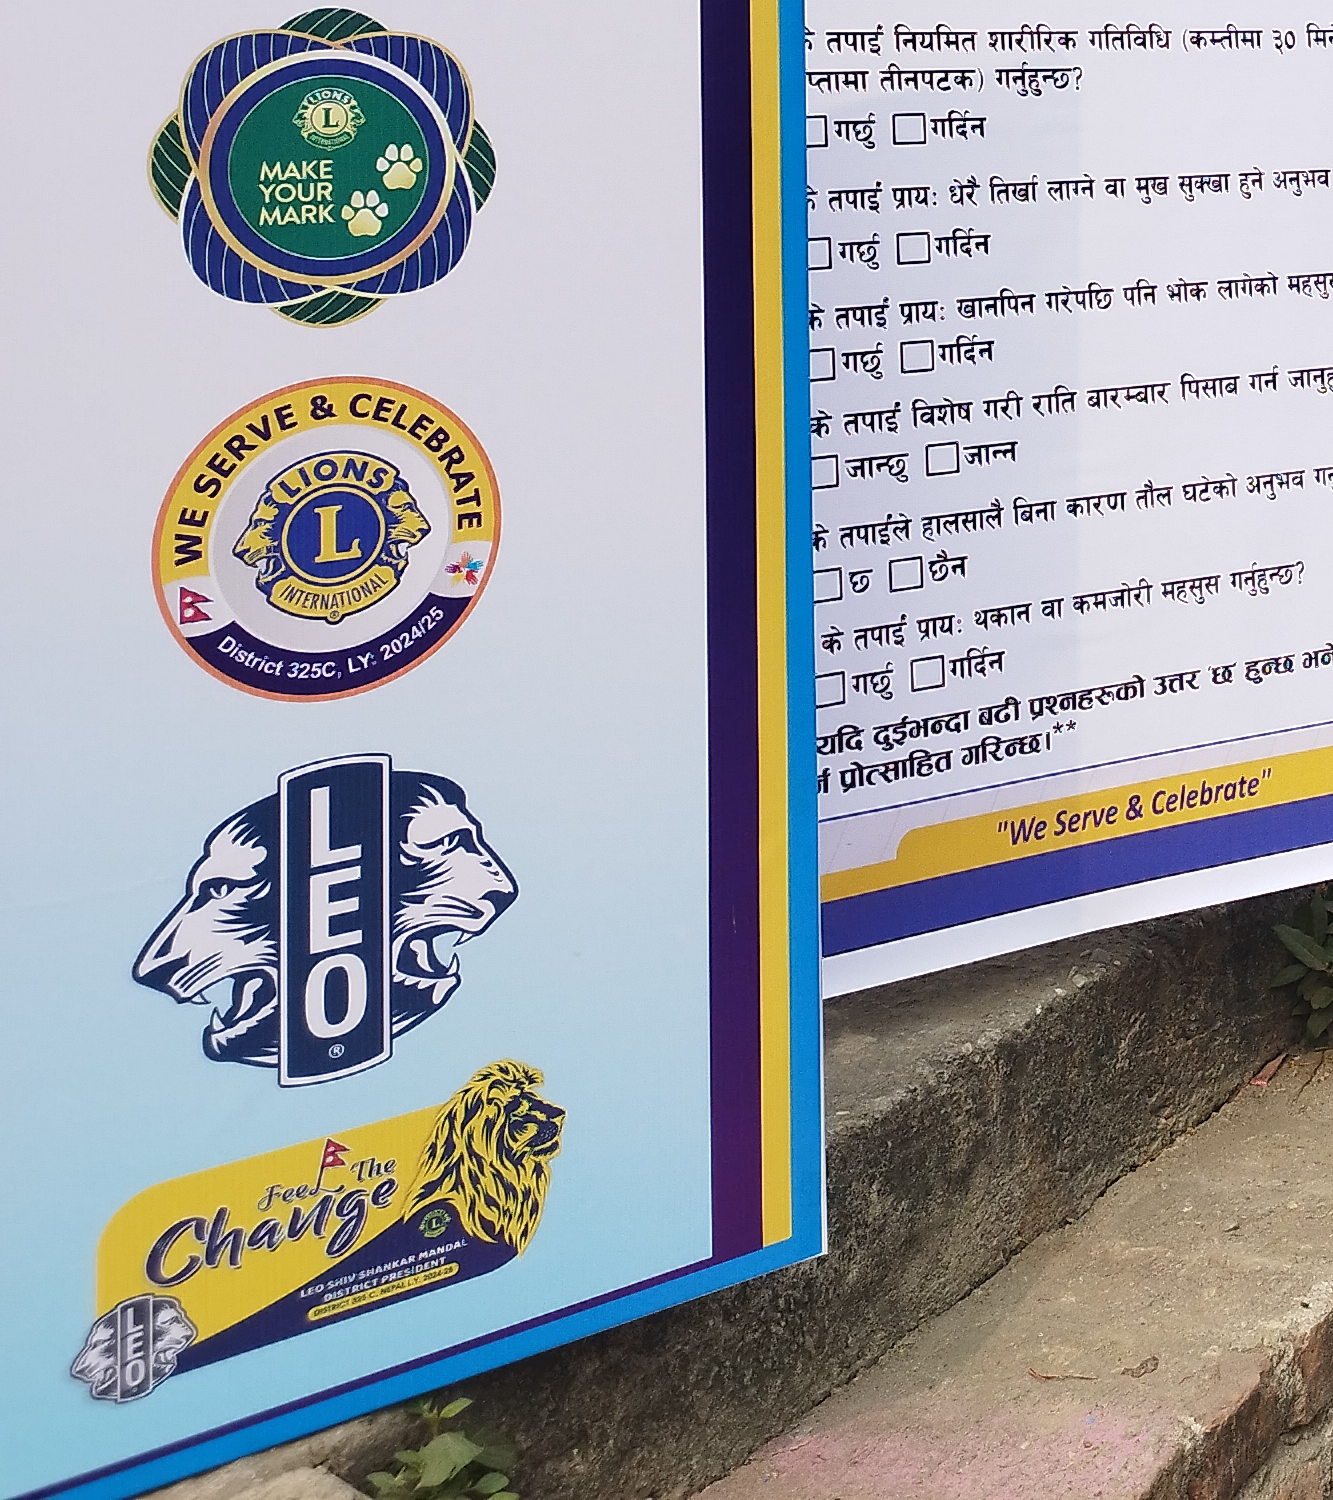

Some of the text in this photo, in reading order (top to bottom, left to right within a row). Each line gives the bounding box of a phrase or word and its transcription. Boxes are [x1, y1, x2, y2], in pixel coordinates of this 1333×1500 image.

[894, 24, 978, 52] नियमित
[988, 24, 1078, 52] शारीरिक
[1088, 23, 1172, 51] गतिविधि
[1182, 24, 1263, 52] (कम्तीमा
[1271, 29, 1296, 55] ३०
[880, 63, 984, 92] तीनपटक)
[308, 89, 351, 105] LIONS
[322, 107, 340, 129] L
[260, 159, 334, 182] MAKE
[949, 168, 1331, 207] धेरै सुक्खा अनुभव
[258, 182, 334, 204] YOUR
[259, 204, 336, 227] MARK
[957, 288, 1035, 321] खानपिन
[1087, 370, 1239, 411] बारम्बार पिसाब
[173, 392, 483, 568] WE SERVE & CELEBRATE
[278, 457, 390, 499] LIONS
[921, 473, 1238, 542] हालसालै घटेको
[314, 504, 362, 564] L
[280, 572, 390, 610] INTERNATIONAL
[974, 602, 1032, 630] थकान
[217, 634, 283, 677] District
[287, 661, 343, 679] 325C,
[379, 605, 445, 661] 2024/25
[1154, 670, 1201, 696] उत्तर
[840, 751, 954, 789] प्रोत्साहित
[996, 768, 1272, 845] "We Serve & Celebrate"
[304, 785, 369, 1038] LEO
[349, 1156, 398, 1183] The
[144, 1176, 400, 1288] Change
[300, 1284, 326, 1299] LEO
[355, 1255, 417, 1278] SHANKAR
[418, 1238, 468, 1261] MANDAL
[323, 1256, 447, 1303] DISTRICT PRESIDENT
[123, 1305, 147, 1390] LEO
